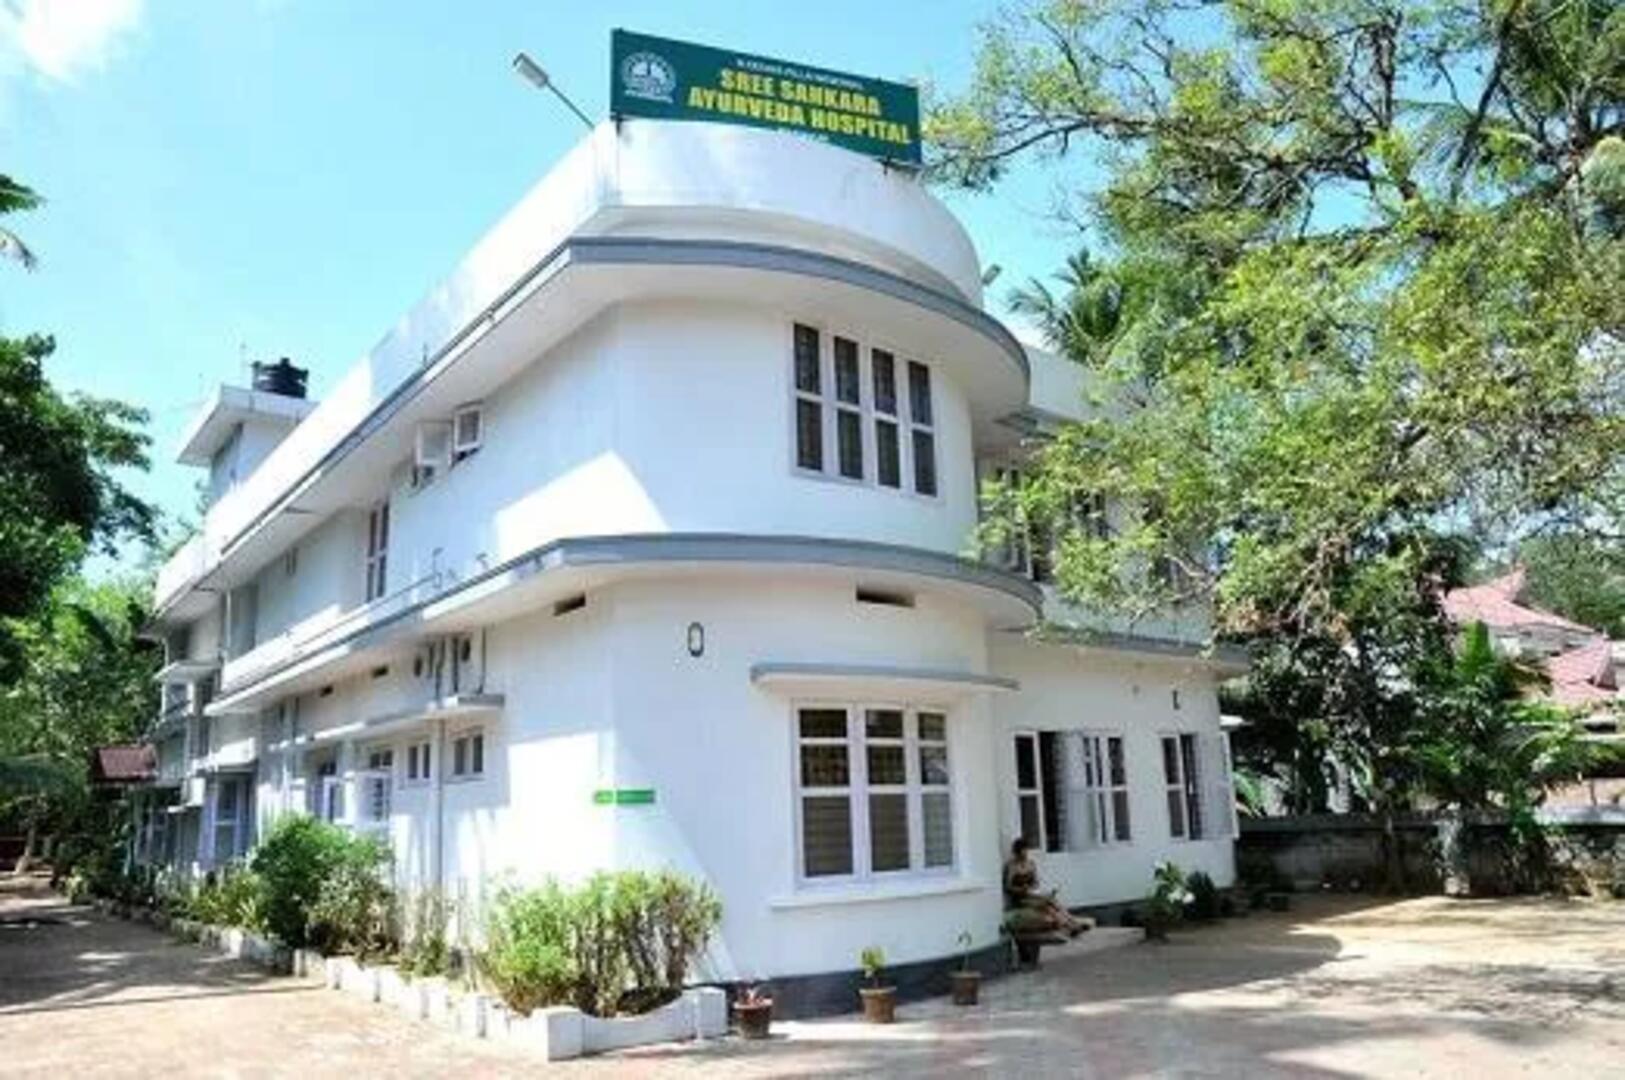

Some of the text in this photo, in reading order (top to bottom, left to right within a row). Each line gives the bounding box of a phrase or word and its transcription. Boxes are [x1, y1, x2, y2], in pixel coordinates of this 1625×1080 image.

[688, 86, 805, 124] AYURVEDA
[810, 108, 911, 144] HOSPITAL
[720, 67, 774, 97] SREE
[780, 80, 881, 115] SANKARA
